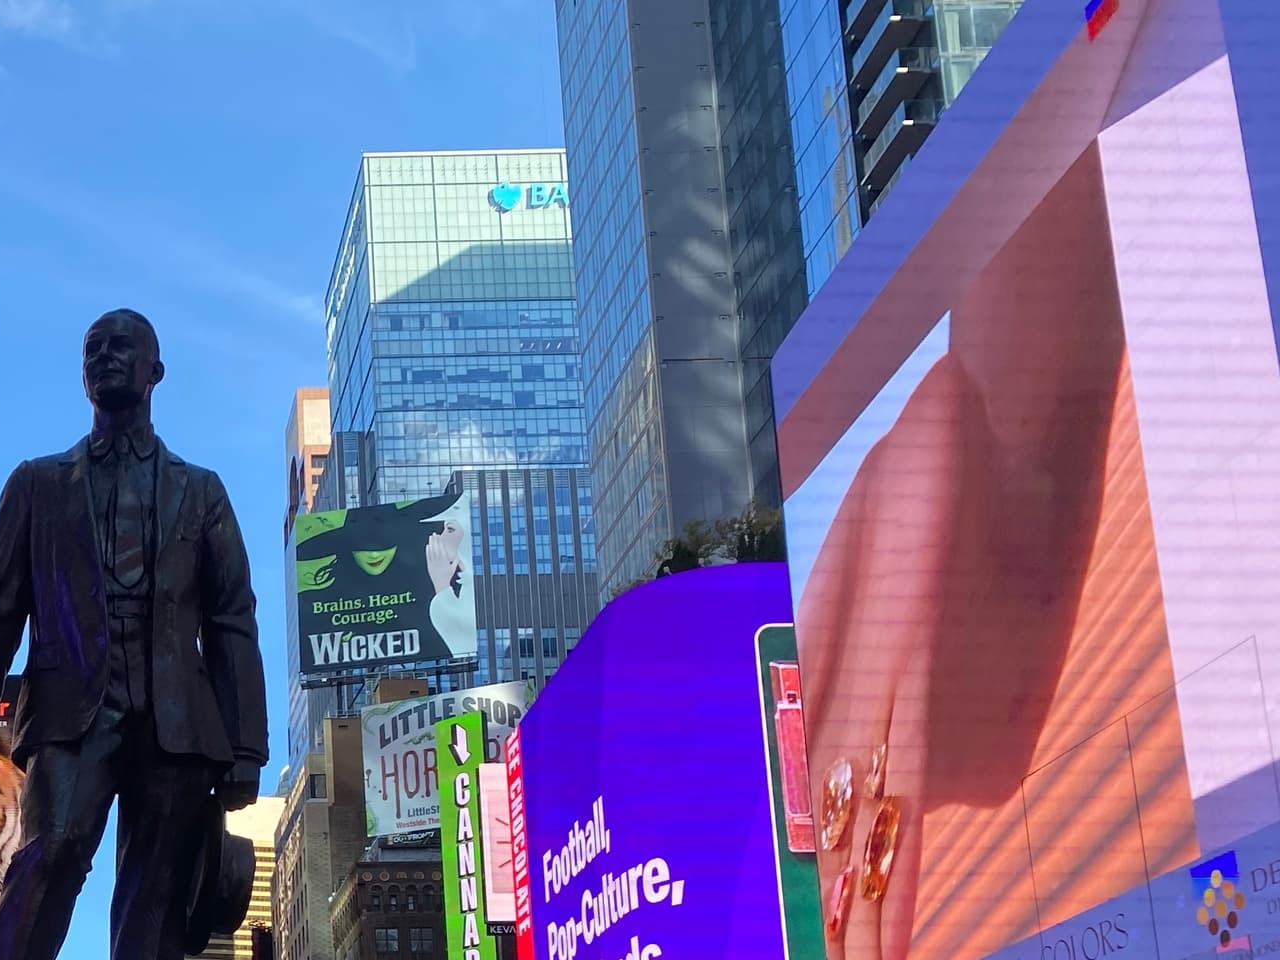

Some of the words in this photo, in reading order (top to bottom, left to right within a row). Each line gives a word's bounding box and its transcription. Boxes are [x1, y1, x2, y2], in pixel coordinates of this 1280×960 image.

[312, 598, 366, 614] Brains.
[368, 591, 416, 607] Heart.
[331, 608, 398, 626] Courage.
[379, 696, 457, 750] LITTLE
[462, 696, 522, 729] SHOP
[542, 795, 611, 903] Football,
